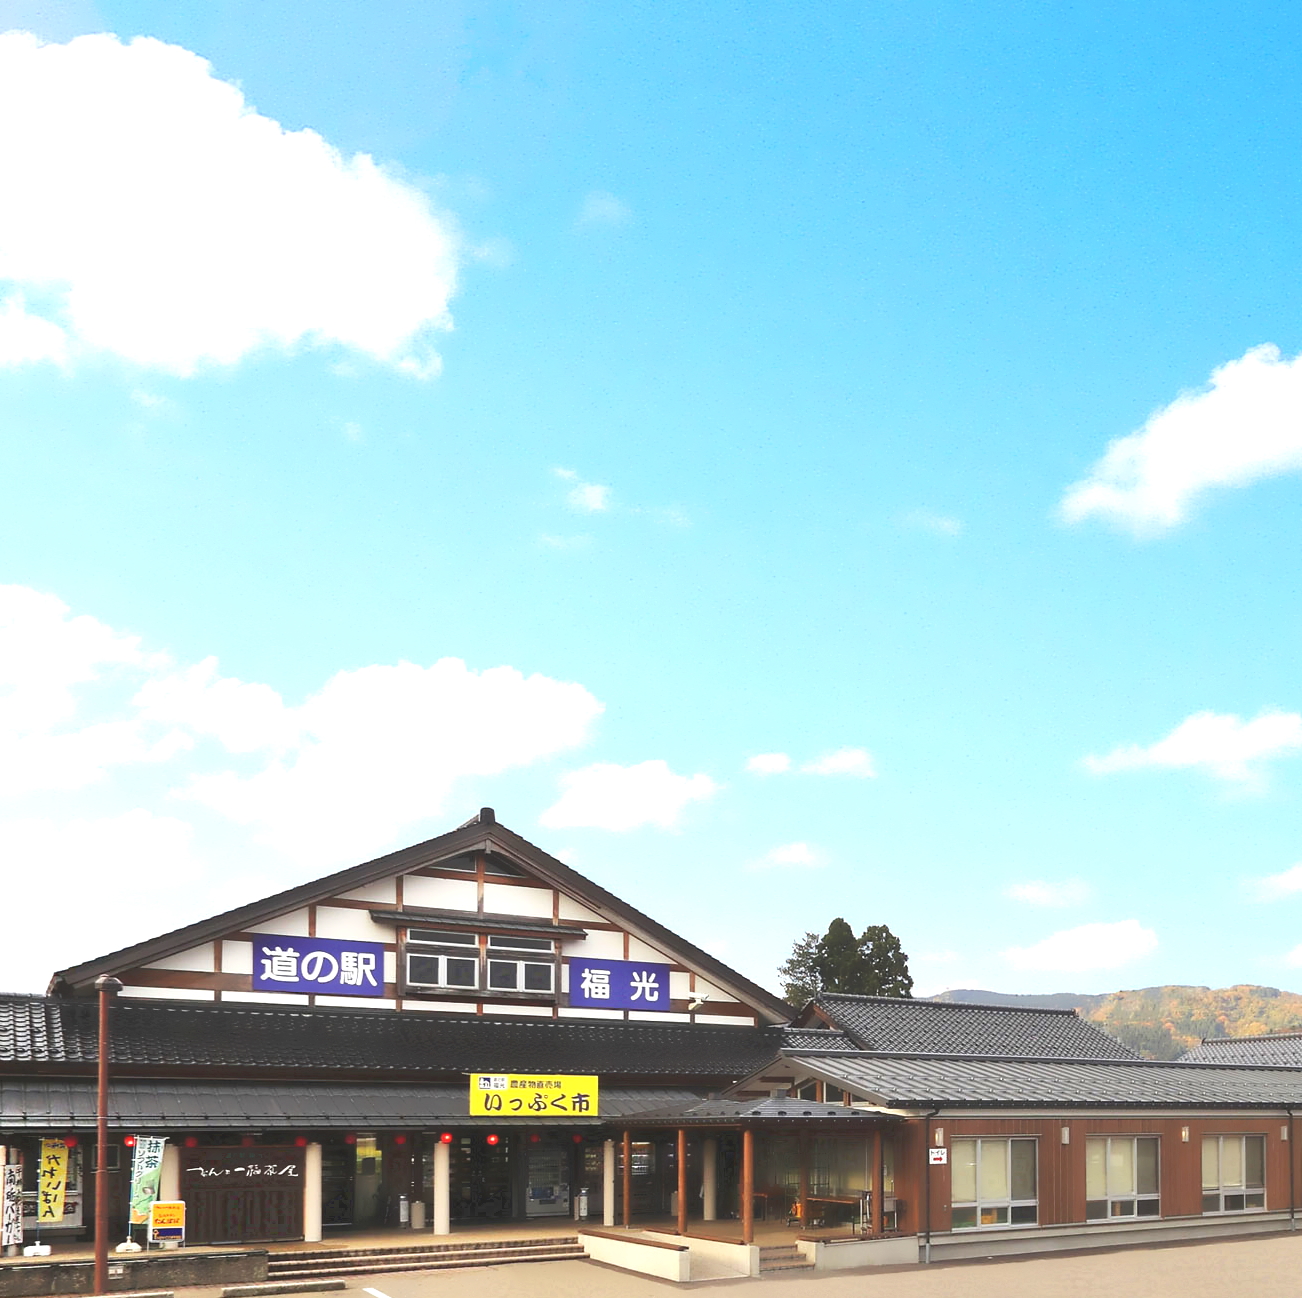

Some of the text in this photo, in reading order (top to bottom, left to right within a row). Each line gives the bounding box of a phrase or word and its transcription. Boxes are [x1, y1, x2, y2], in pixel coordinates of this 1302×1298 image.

[259, 946, 378, 987] 道の駅
[580, 968, 660, 1002] 福光
[510, 1080, 562, 1089] 農産物直売場
[484, 1093, 590, 1113] いっぷく市
[145, 1140, 162, 1169] 抹茶
